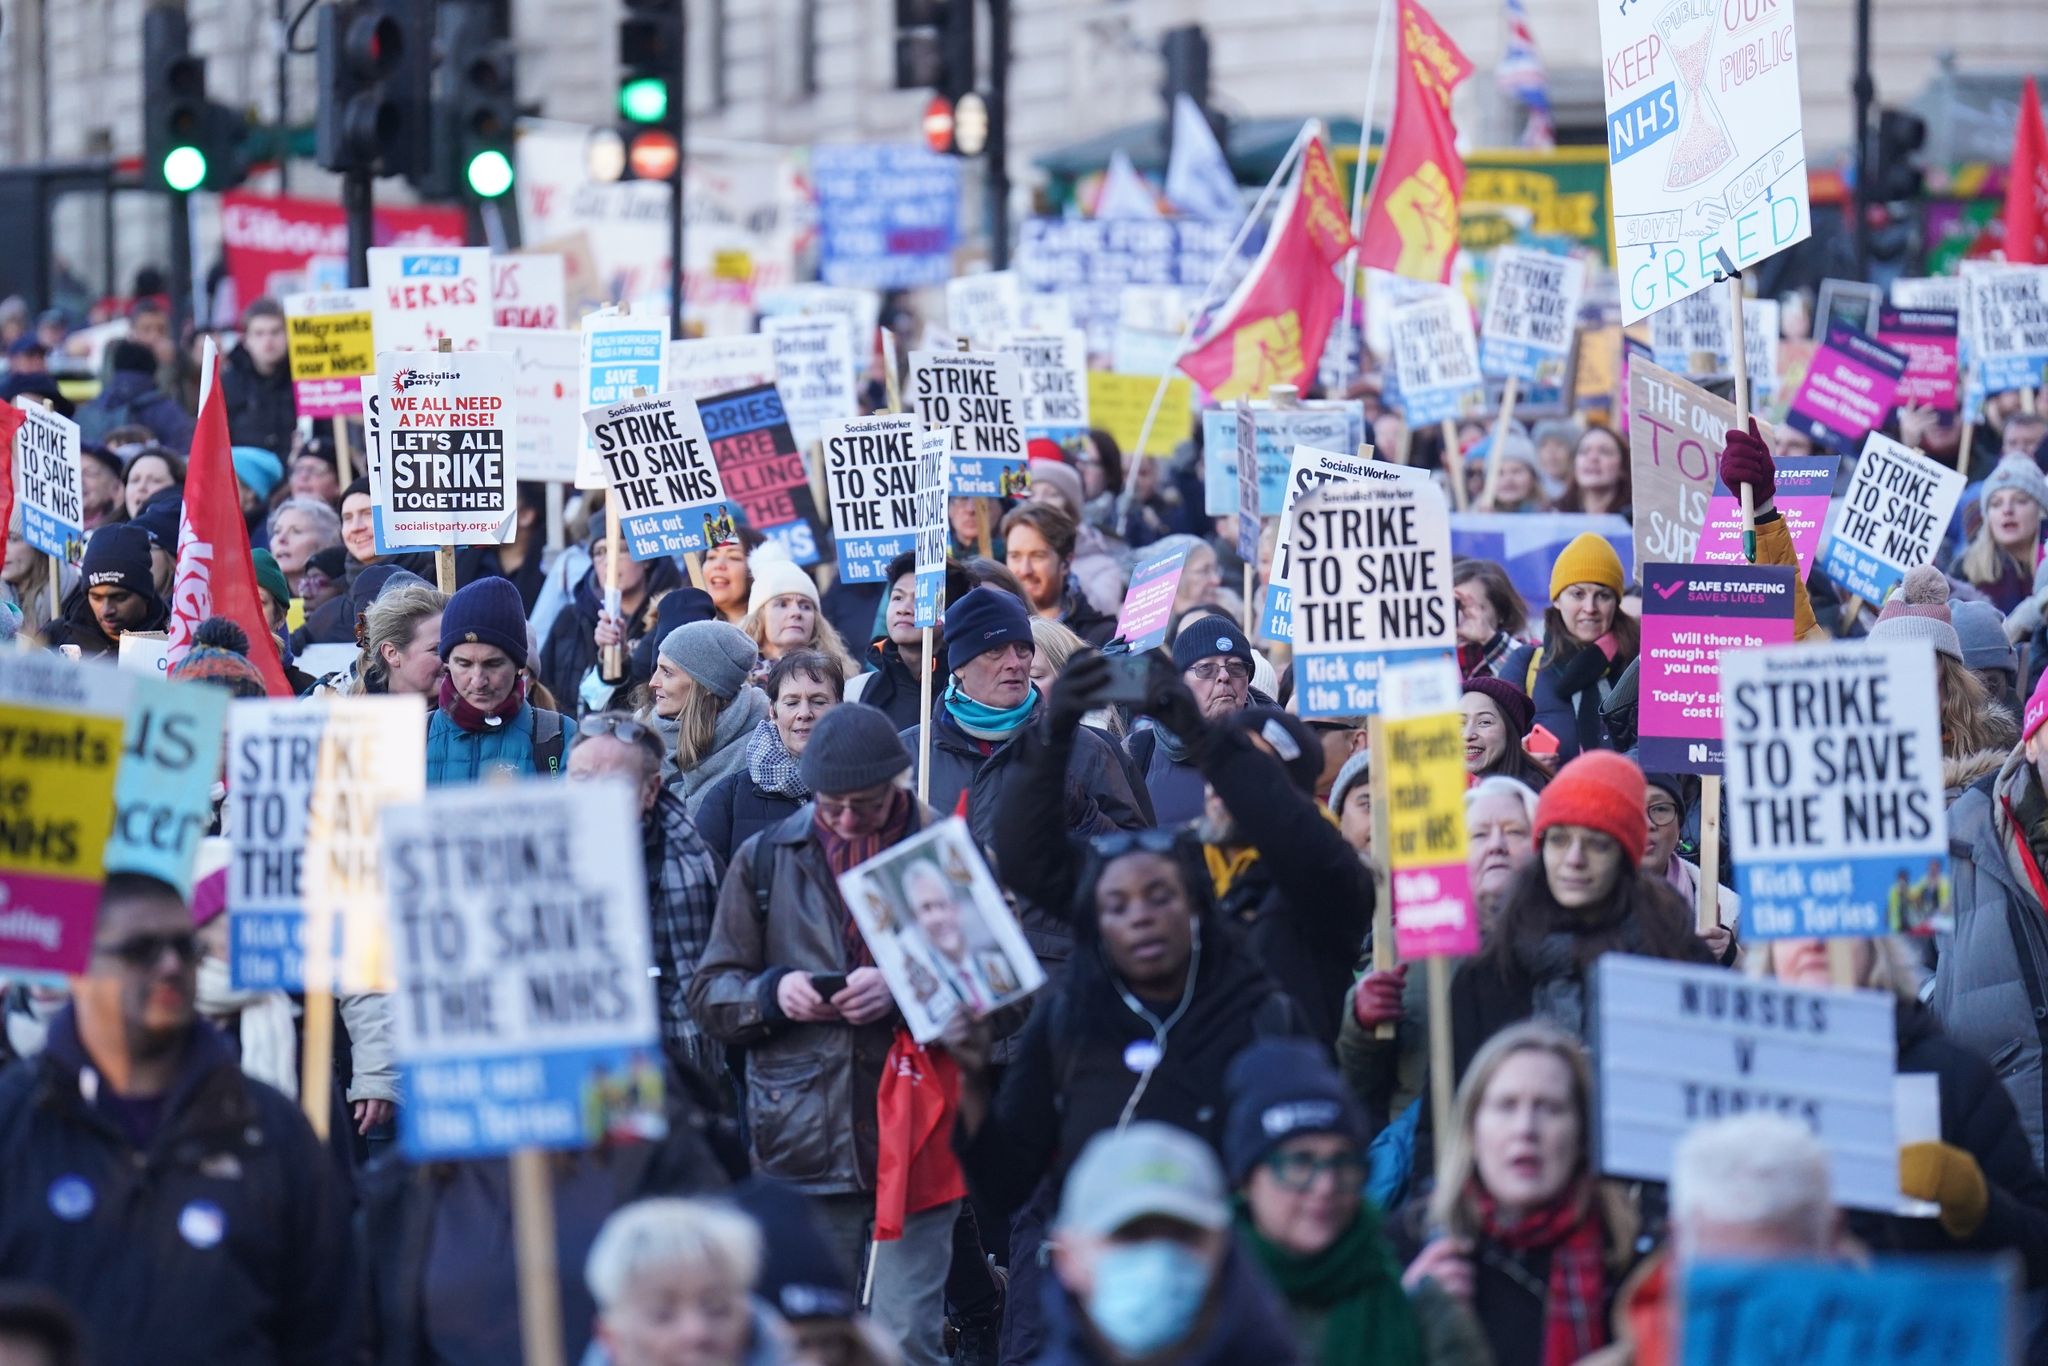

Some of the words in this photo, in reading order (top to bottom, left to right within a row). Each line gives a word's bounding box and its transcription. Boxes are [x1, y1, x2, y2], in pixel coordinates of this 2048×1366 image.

[1607, 34, 1660, 97] KEEP
[1720, 25, 1793, 92] PUBLIC
[1613, 88, 1675, 155] NHS
[1631, 196, 1799, 310] GREED
[408, 371, 460, 380] Socialist
[605, 369, 638, 385] SAVE
[917, 367, 999, 396] STRIKE
[391, 397, 417, 411] WE
[422, 398, 447, 410] ALL
[456, 397, 502, 410] NEED
[703, 398, 784, 433] ORIES
[919, 397, 949, 423] TO
[959, 398, 1015, 425] SAVE
[1641, 376, 1687, 427] THE
[399, 414, 411, 427] A
[415, 414, 445, 427] PAY
[450, 413, 494, 427] RISE!
[594, 410, 682, 451] STRIKE
[21, 416, 67, 462] STRIKE
[392, 433, 451, 451] LET'S
[460, 433, 501, 450] ALL
[829, 432, 916, 468] STRIKE
[975, 425, 1021, 454] NHS
[22, 444, 38, 474] TO
[44, 456, 76, 494] SAVE
[394, 453, 503, 488] STRIKE
[604, 448, 640, 480] TO
[645, 439, 704, 475] SAVE
[722, 457, 805, 497] LLING
[1780, 470, 1829, 478] STAFFING
[23, 473, 47, 508] THE
[52, 487, 79, 523] NHS
[614, 477, 663, 511] THE
[665, 469, 717, 504] NHS
[832, 470, 864, 499] TO
[874, 465, 916, 498] SAV
[1862, 452, 1938, 509] STRIKE
[394, 493, 502, 508] TOGETHER
[836, 501, 884, 533] THE
[925, 492, 944, 526] SAVE
[1679, 483, 1707, 527] IS
[1788, 509, 1802, 517] be
[1853, 479, 1880, 513] TO
[1883, 497, 1937, 543] SAVE
[630, 517, 660, 537] Kick
[663, 515, 684, 531] out
[635, 537, 660, 555] the
[662, 532, 701, 551] Tories
[1298, 506, 1418, 551] STRIKE
[1719, 531, 1740, 540] you
[1843, 507, 1882, 548] THE
[1882, 531, 1929, 569] NHS
[845, 542, 874, 559] Kick
[878, 541, 900, 558] out
[928, 529, 944, 565] NHS
[848, 562, 870, 579] the
[1298, 555, 1341, 598] TO
[1358, 551, 1437, 594] SAVE
[1688, 581, 1721, 593] SAFE
[1723, 582, 1786, 595] STAFFING
[1688, 592, 1724, 603] SAVES
[1727, 593, 1766, 604] LIVES
[1300, 601, 1366, 643] THE
[1381, 596, 1445, 639] NHS
[1650, 648, 1704, 661] enough
[1672, 632, 1701, 644] Will
[1704, 633, 1742, 645] there
[1744, 635, 1765, 647] be
[1306, 655, 1349, 683] Kick
[1664, 663, 1690, 675] you
[1307, 685, 1340, 711] the
[1652, 690, 1705, 705] Today's
[1682, 707, 1712, 717] cost
[1734, 675, 1889, 732] STRIKE
[1736, 739, 1791, 788] TO
[1812, 731, 1919, 787] SAVE
[240, 793, 286, 840] TO
[1737, 794, 1824, 847] THE
[1844, 789, 1931, 843] NHS
[240, 847, 306, 898] THE
[393, 831, 575, 898] STRIKE
[1751, 868, 1805, 895] Kick
[1810, 864, 1853, 893] out
[1751, 906, 1797, 934] the
[1803, 898, 1878, 930] Tories
[401, 909, 468, 964] TO
[1678, 979, 1830, 1035] NURSES
